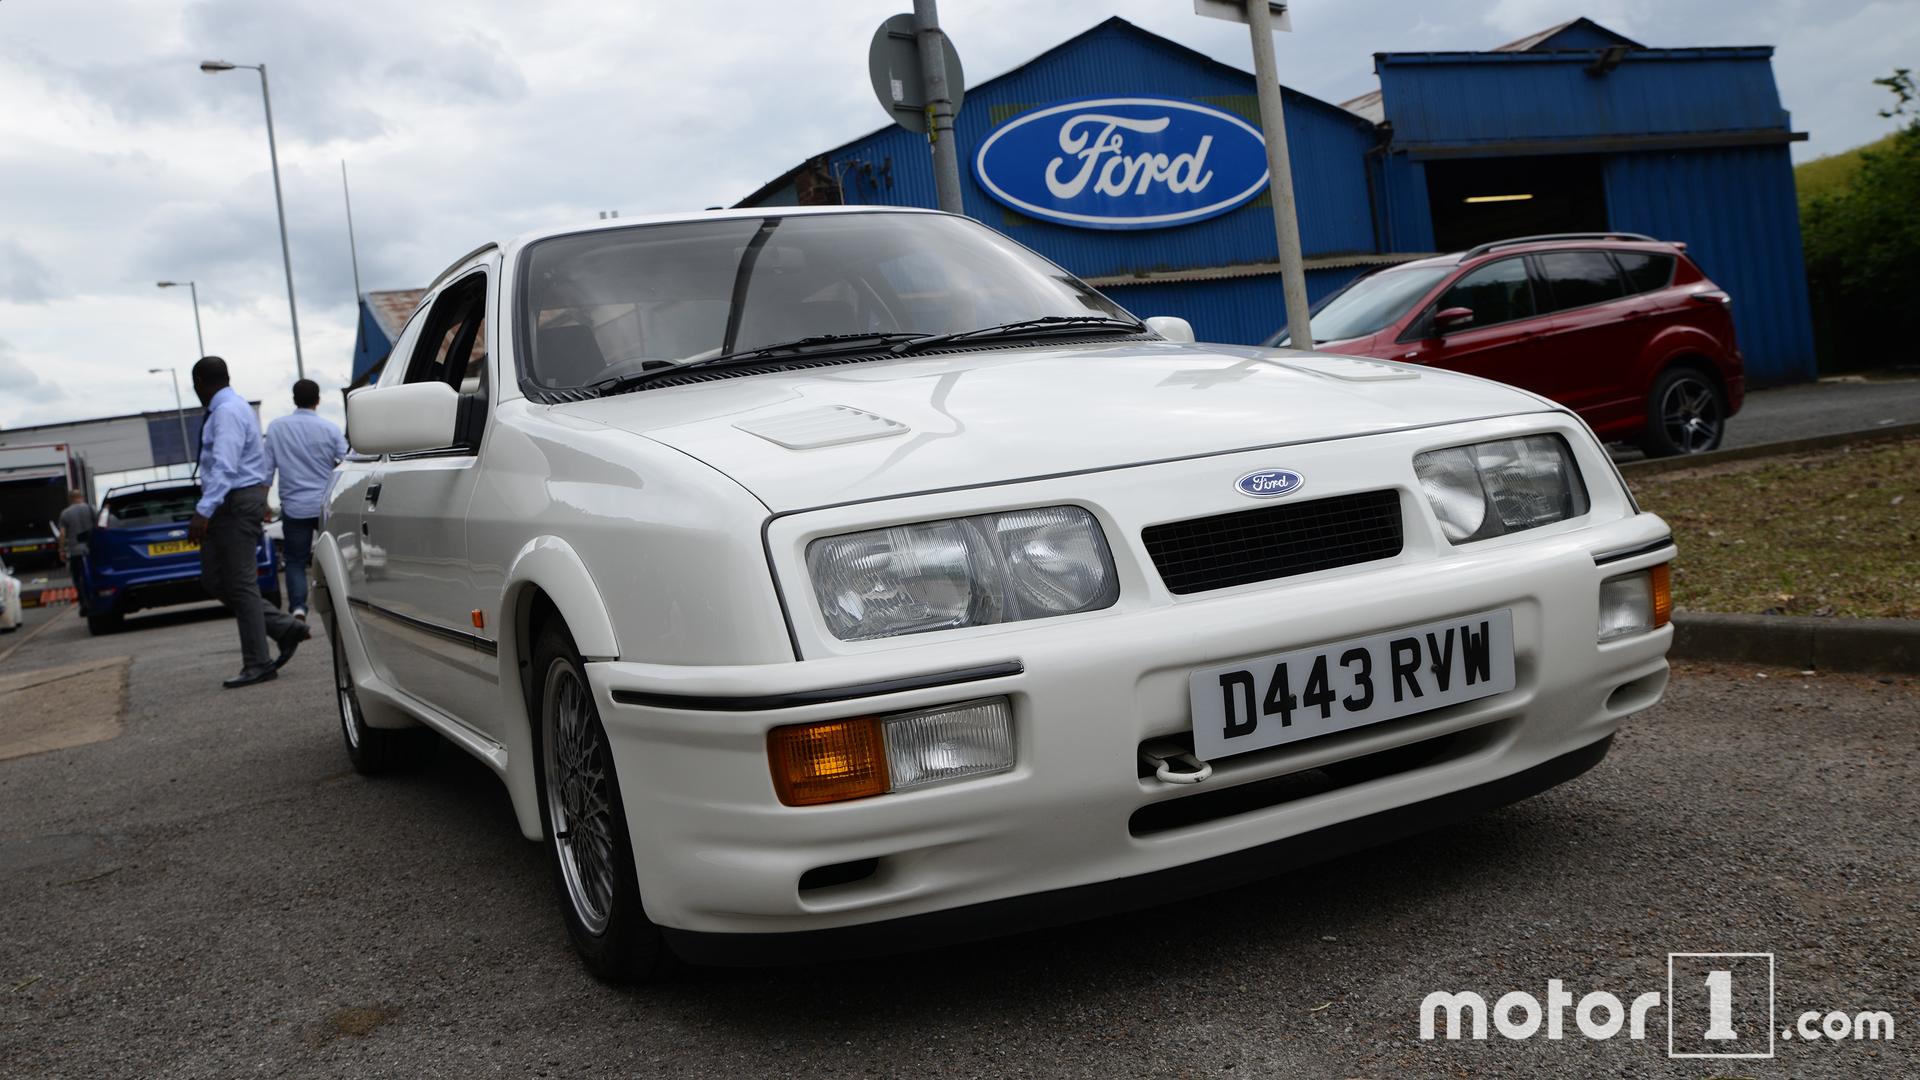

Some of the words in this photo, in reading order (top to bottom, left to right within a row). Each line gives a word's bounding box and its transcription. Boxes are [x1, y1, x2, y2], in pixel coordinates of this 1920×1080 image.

[1045, 114, 1213, 199] Ford
[1252, 473, 1289, 491] Ford
[1219, 647, 1374, 739] D443
[1390, 621, 1491, 703] RVW
